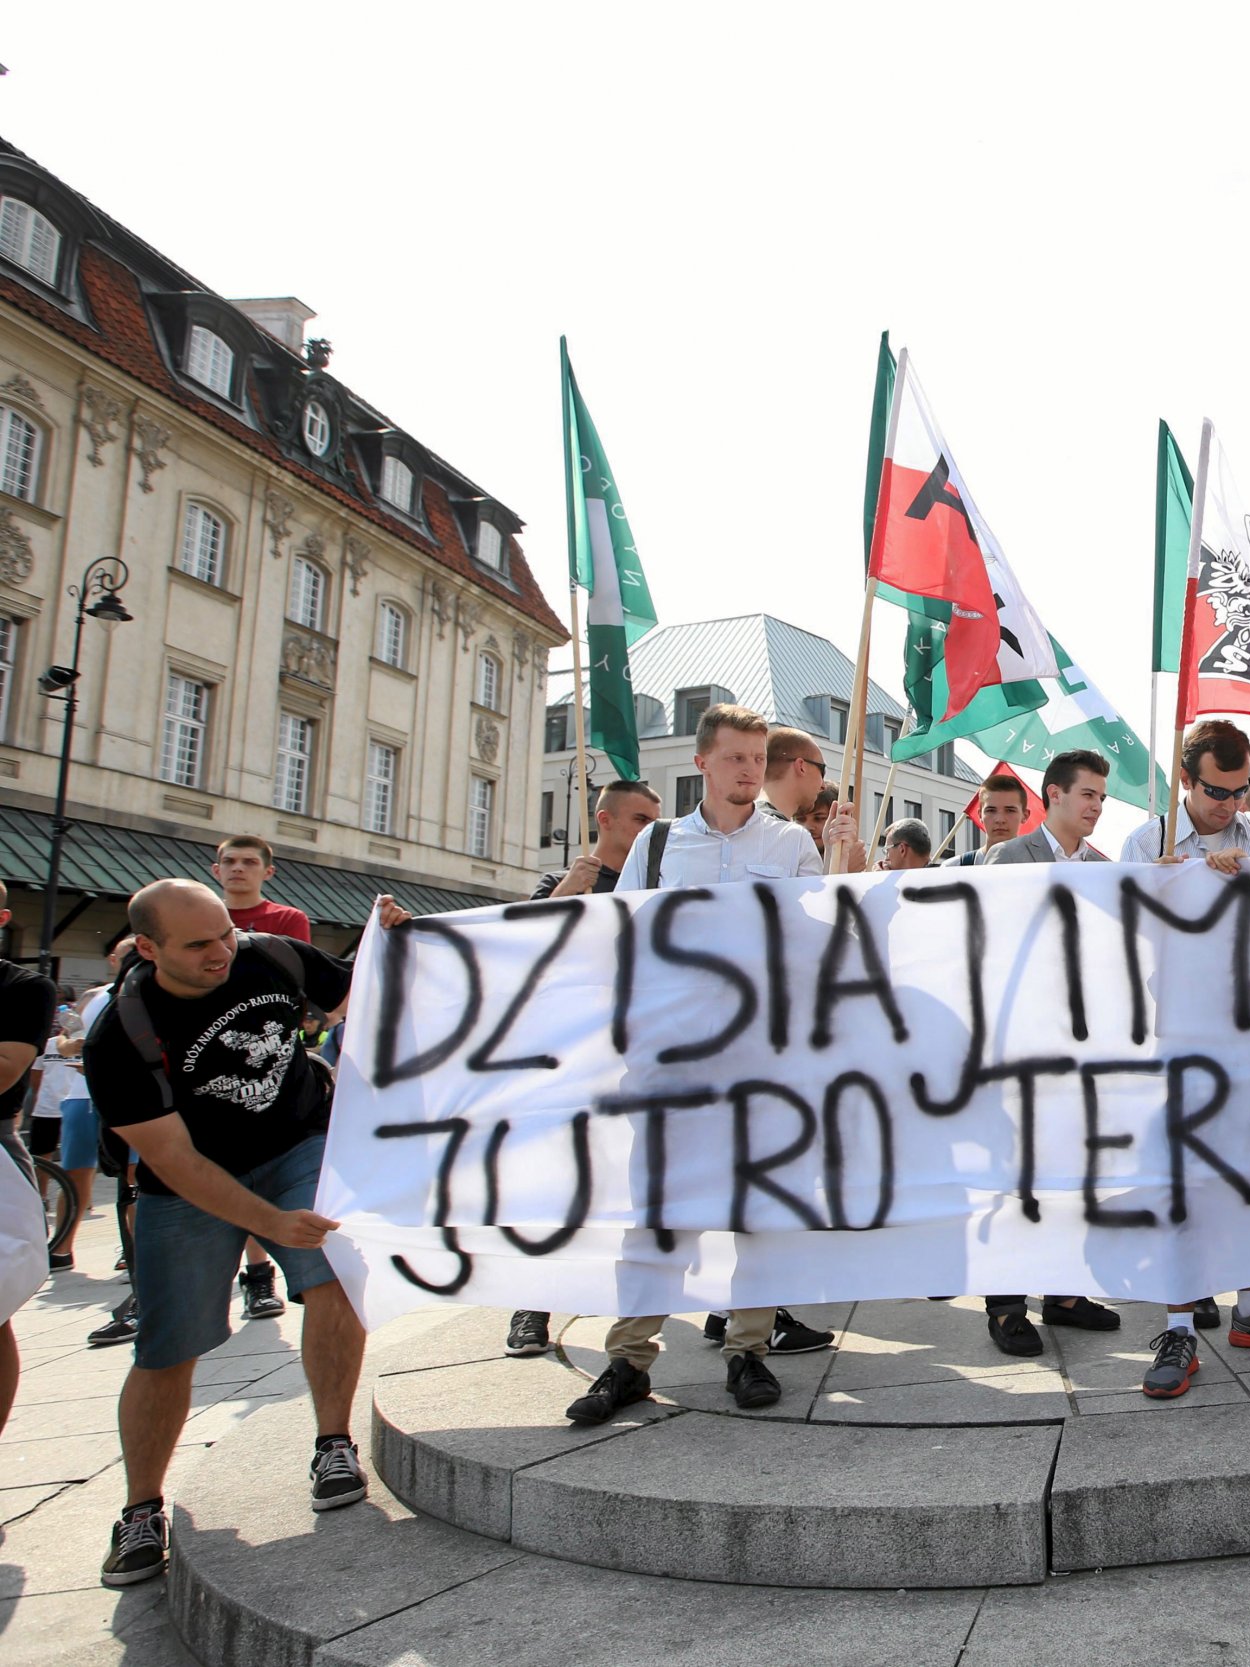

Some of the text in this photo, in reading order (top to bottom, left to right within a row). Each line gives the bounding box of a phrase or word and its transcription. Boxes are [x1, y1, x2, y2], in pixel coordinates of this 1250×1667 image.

[182, 1043, 204, 1073] OBÓZ
[372, 881, 988, 1118] DZISIAJ
[374, 1070, 896, 1297] JUTRO
